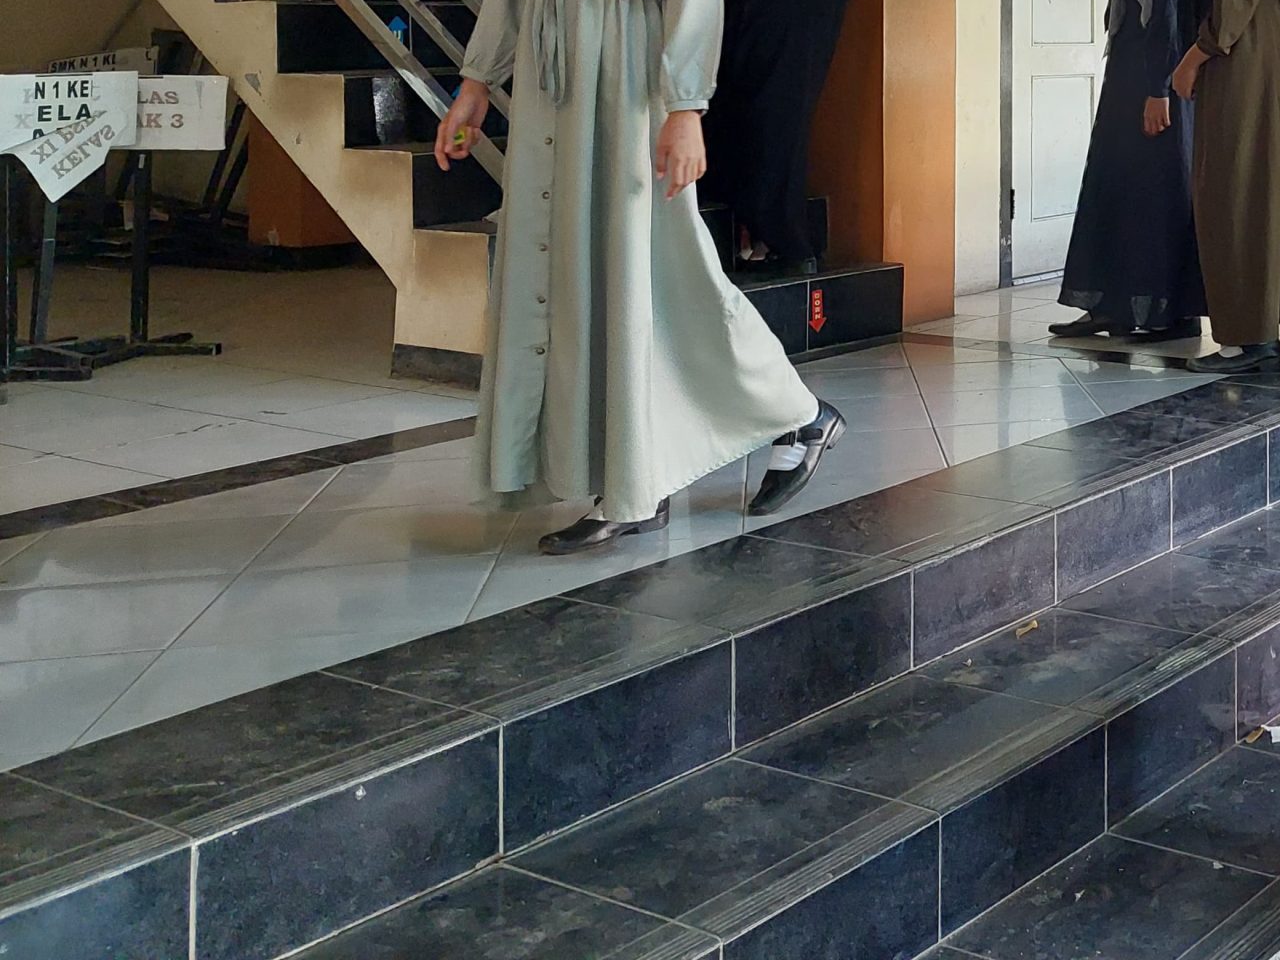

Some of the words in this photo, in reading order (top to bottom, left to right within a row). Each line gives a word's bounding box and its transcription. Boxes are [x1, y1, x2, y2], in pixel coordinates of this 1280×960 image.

[51, 59, 76, 73] SMK
[79, 58, 88, 68] N
[92, 56, 98, 66] 1
[34, 82, 46, 99] N
[52, 81, 59, 99] 1
[171, 113, 184, 129] 3
